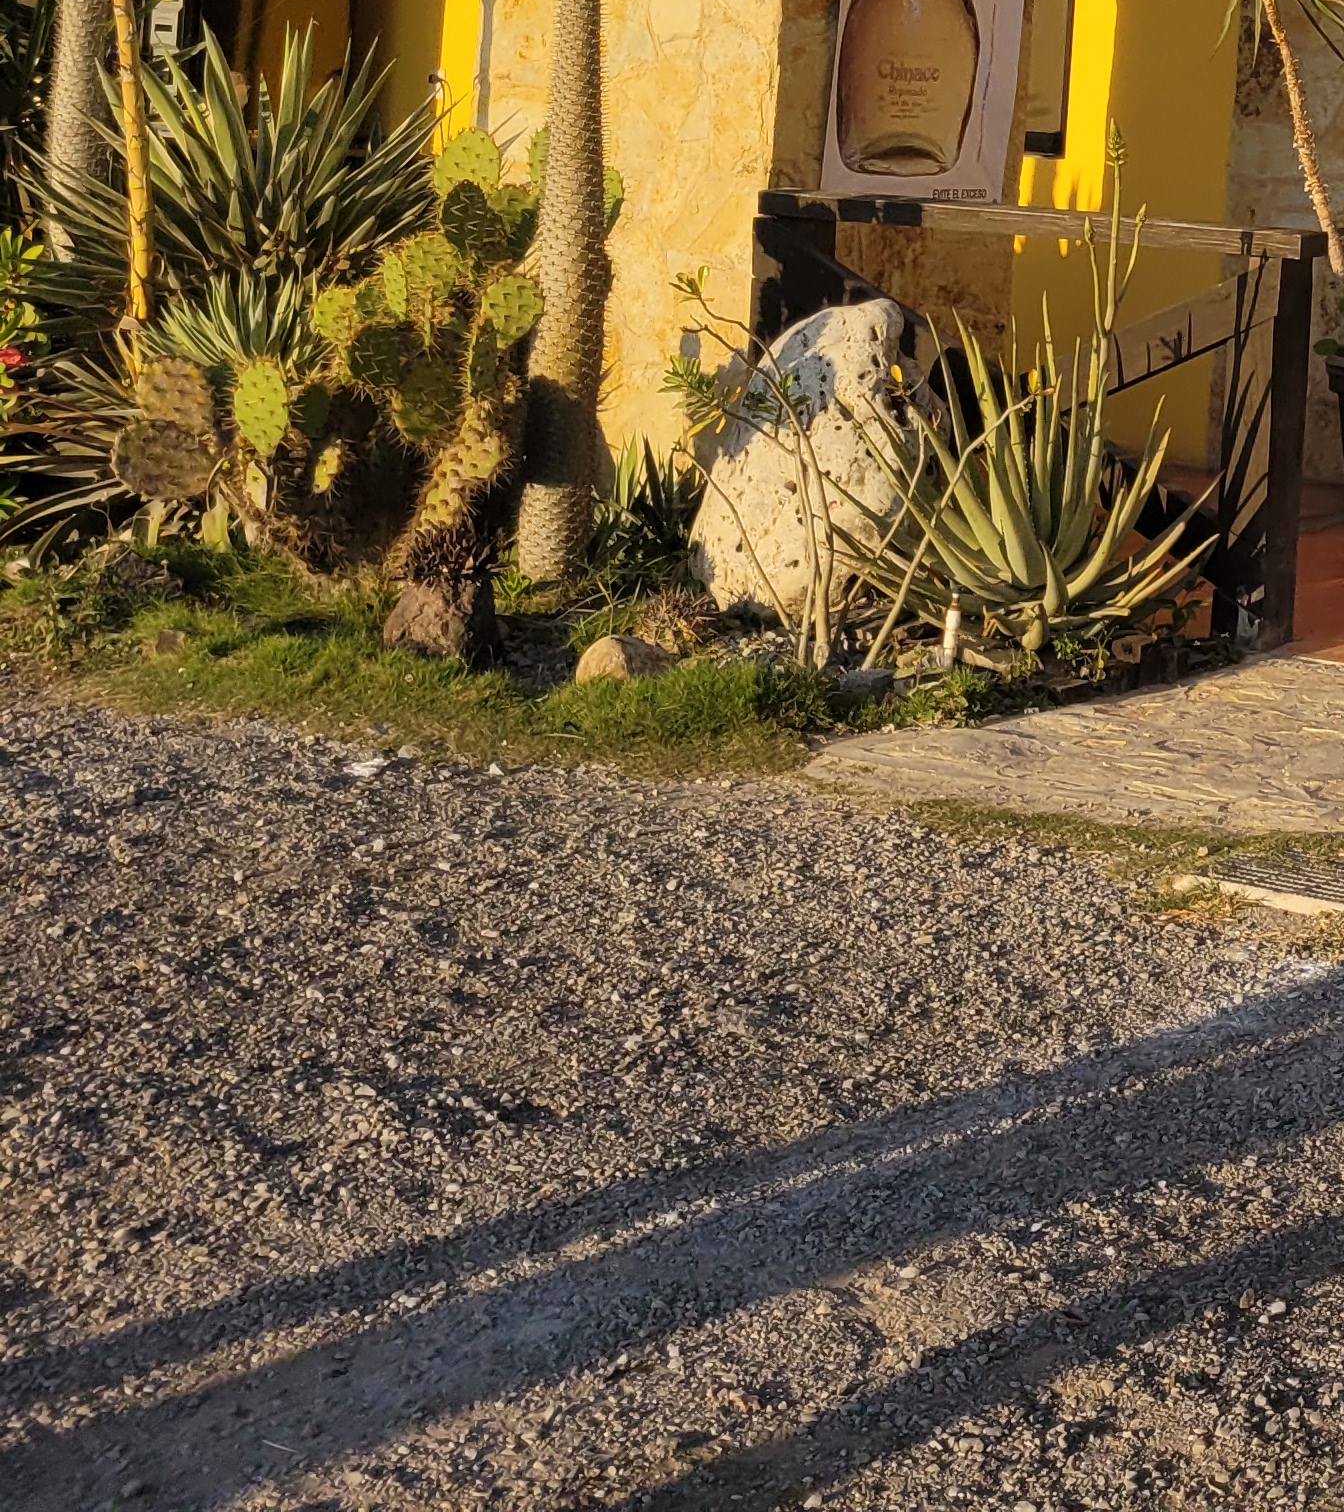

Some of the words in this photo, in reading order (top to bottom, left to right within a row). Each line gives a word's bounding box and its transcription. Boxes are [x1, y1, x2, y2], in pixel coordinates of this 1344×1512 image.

[932, 188, 951, 199] EVITE
[952, 188, 960, 199] EL
[961, 188, 987, 199] EXCESO
